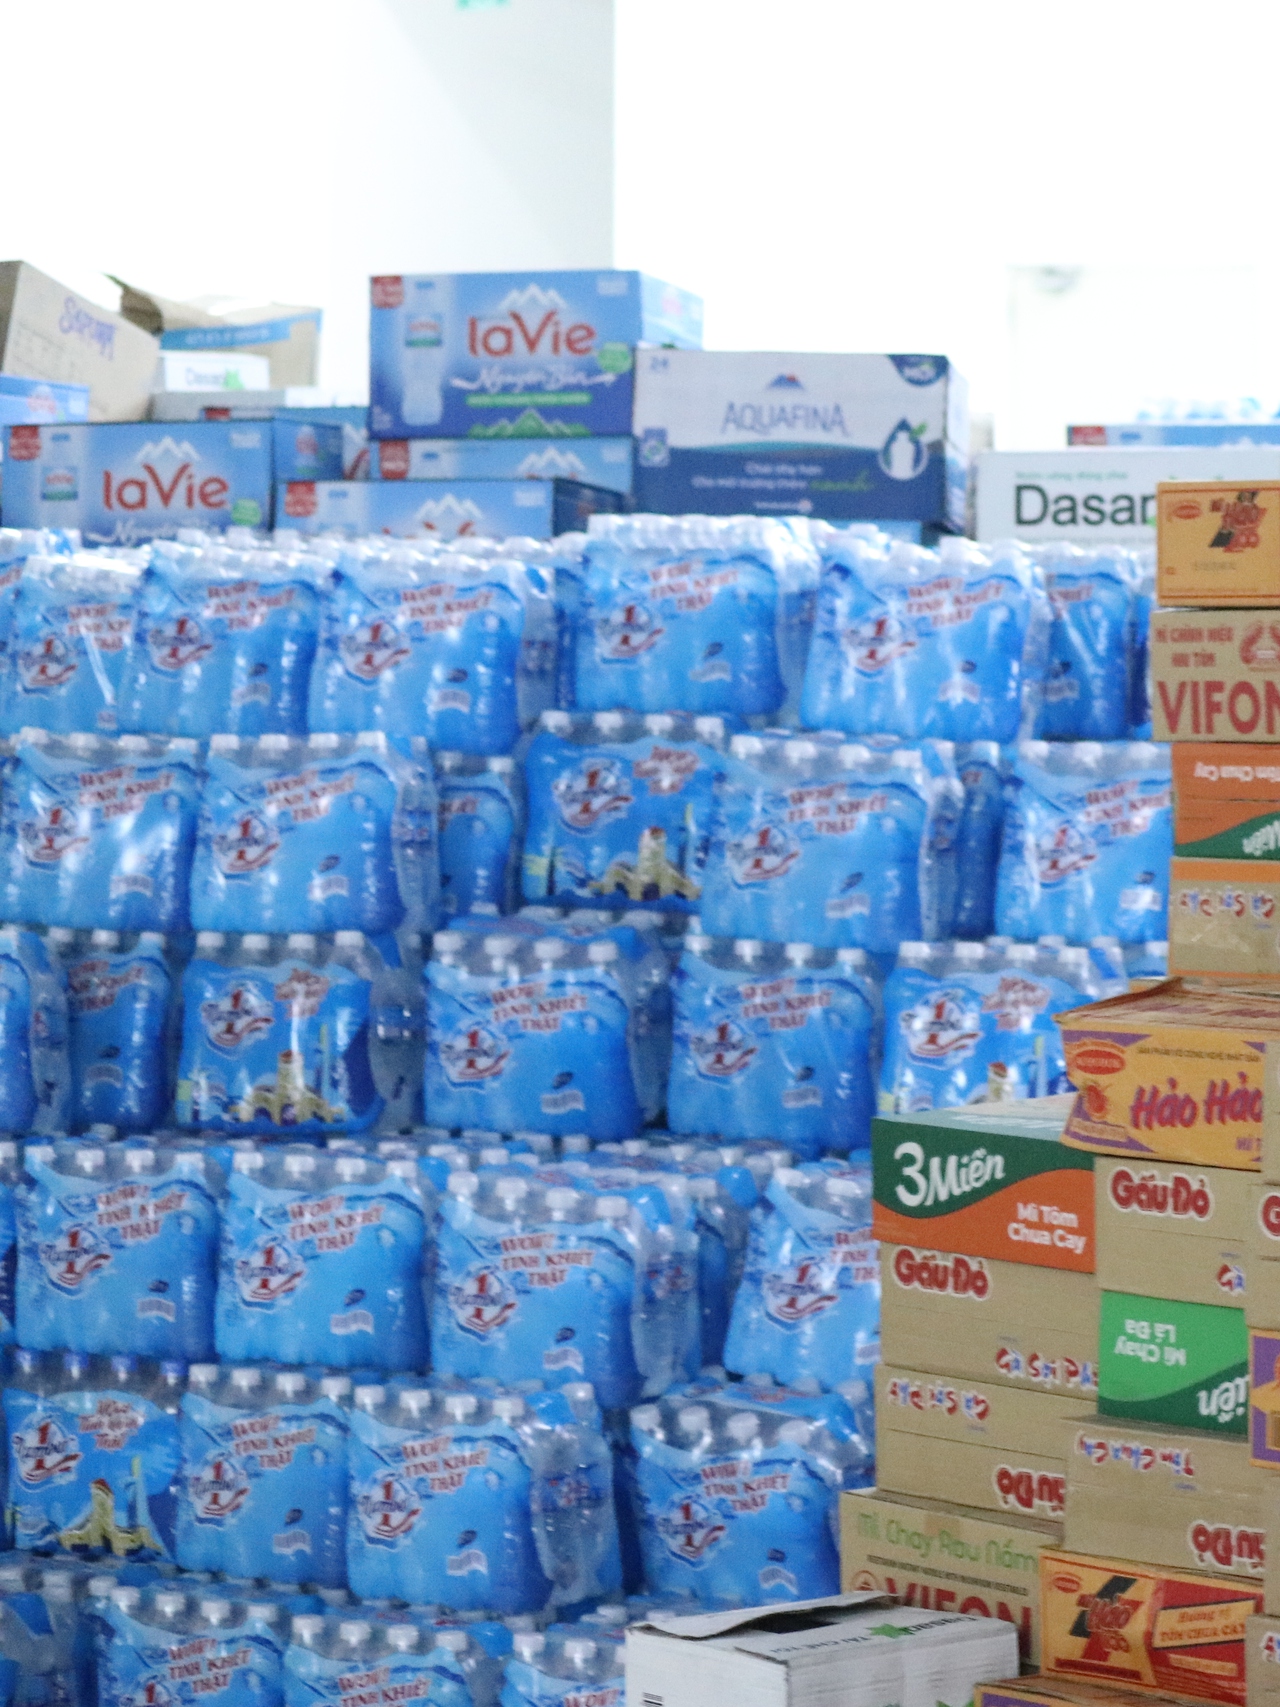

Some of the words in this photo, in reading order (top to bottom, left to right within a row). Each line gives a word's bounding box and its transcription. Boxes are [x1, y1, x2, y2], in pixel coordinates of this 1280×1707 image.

[468, 309, 598, 358] laVie
[721, 402, 850, 437] AQUAFINA
[103, 463, 230, 511] laVie
[1131, 1078, 1197, 1131] Hảo
[1204, 1072, 1262, 1127] Hảo
[1018, 1203, 1039, 1221] Mì
[1043, 1203, 1078, 1229] Tôm
[1008, 1223, 1052, 1245] Chua
[1053, 1227, 1087, 1254] Cay
[1126, 1320, 1150, 1339] Đa
[1150, 1324, 1175, 1345] Lá
[1115, 1336, 1159, 1363] Chay
[1162, 1348, 1187, 1367] Mì
